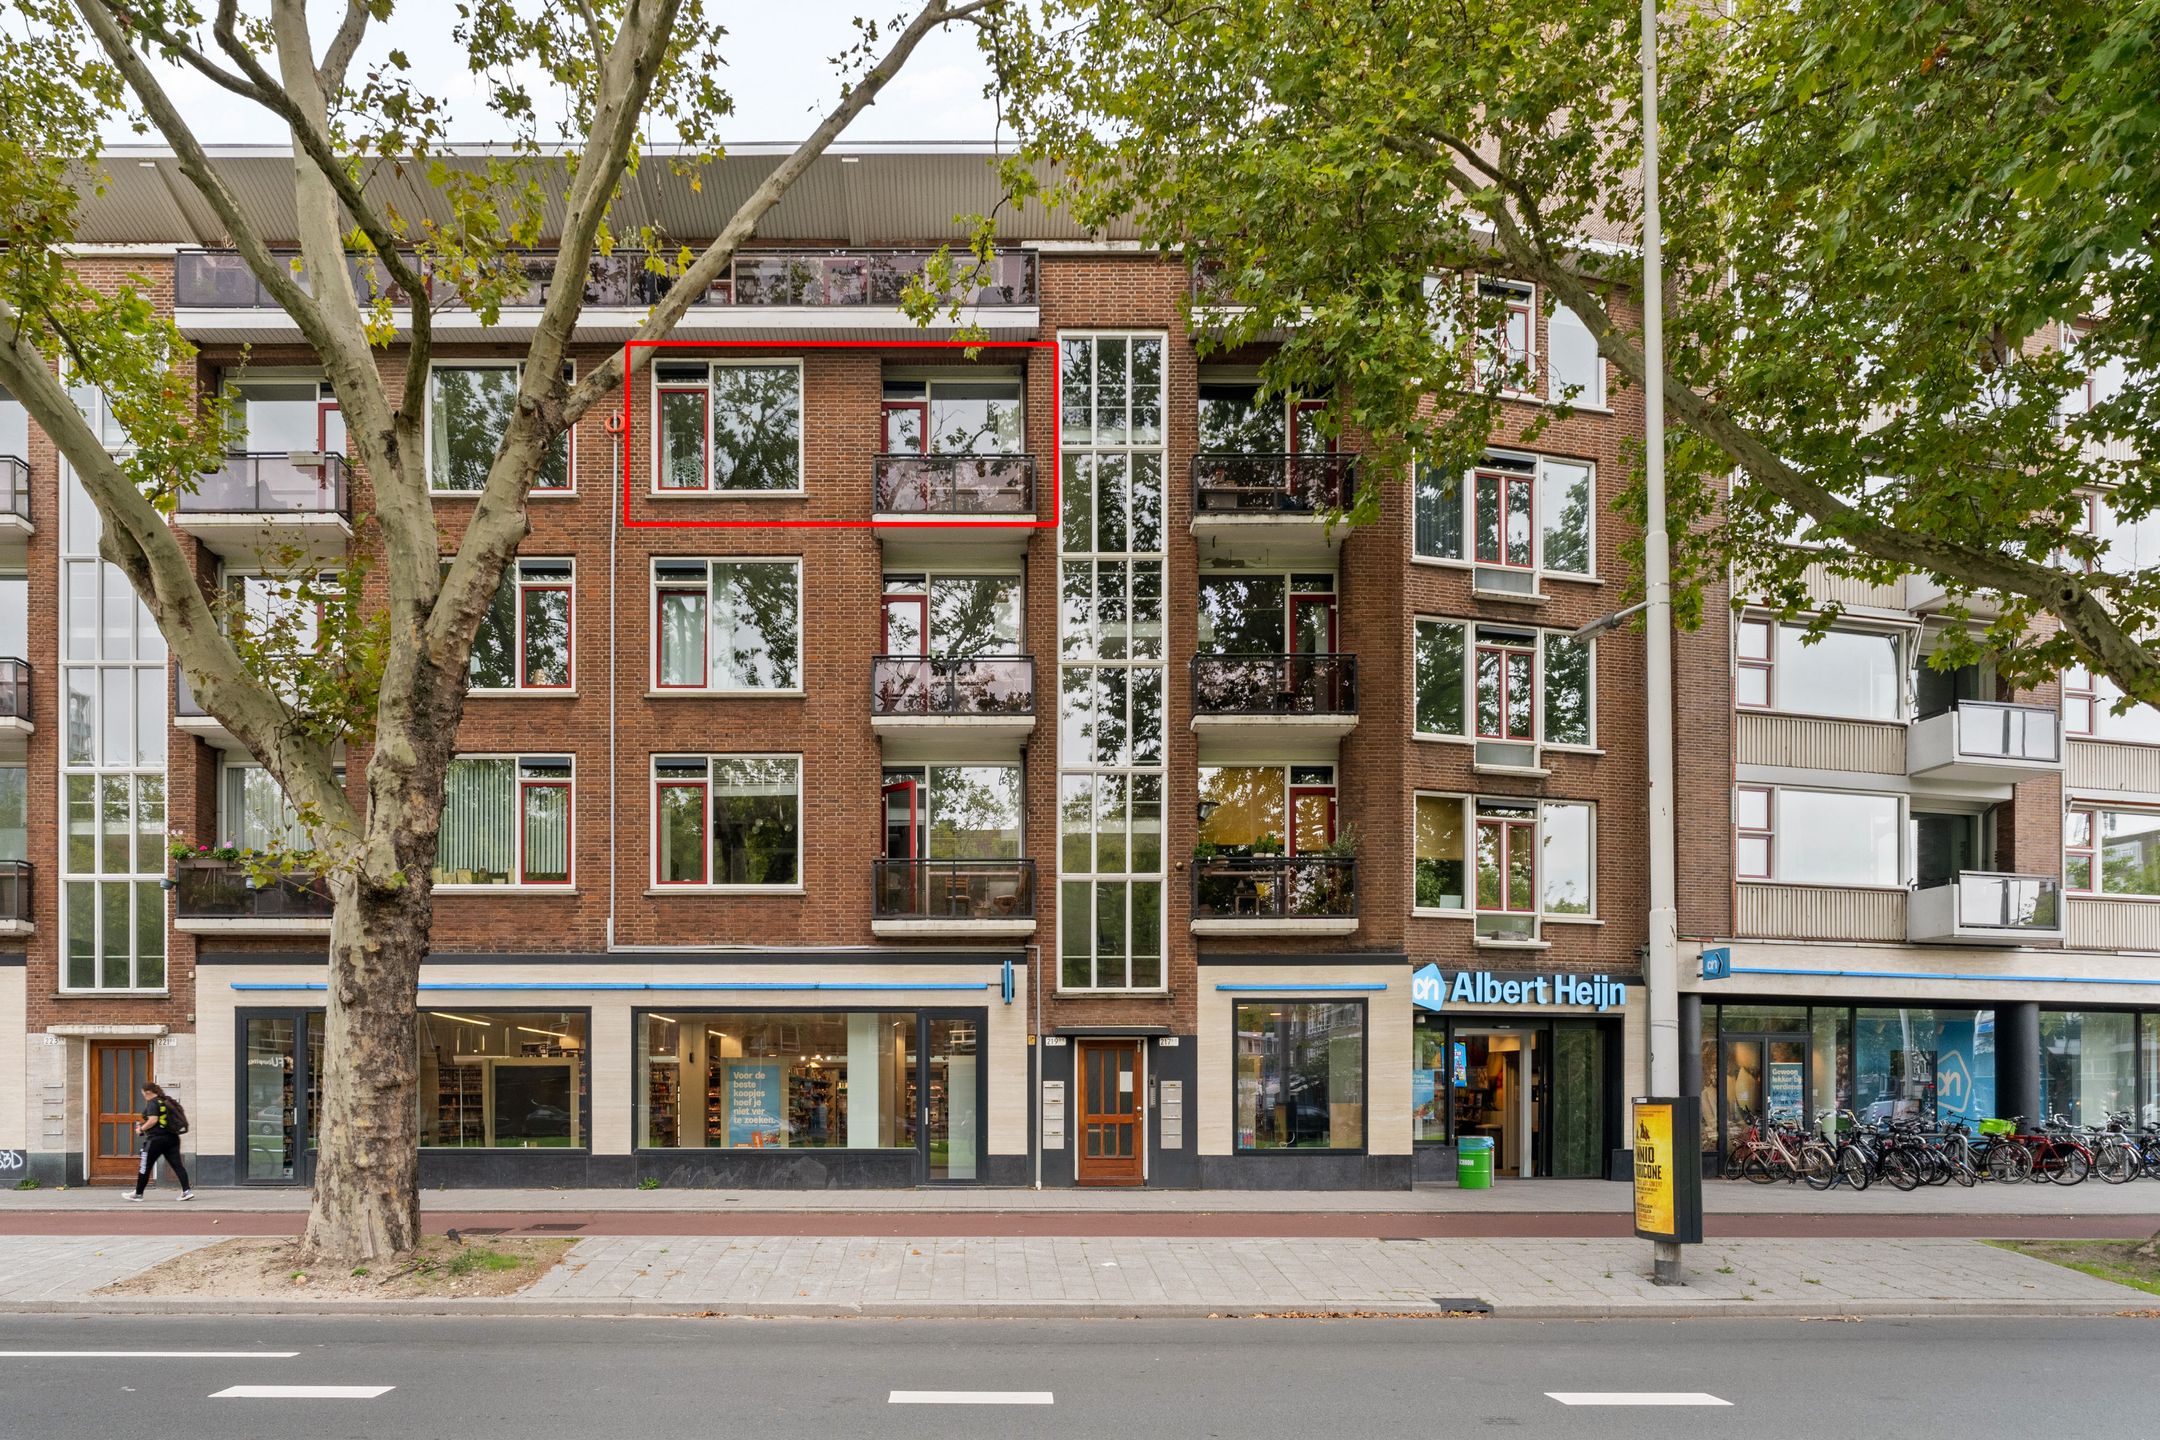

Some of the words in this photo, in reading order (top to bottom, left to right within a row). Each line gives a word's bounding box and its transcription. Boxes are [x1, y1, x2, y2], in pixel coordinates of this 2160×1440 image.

[1450, 971, 1548, 1005] Albert
[1553, 973, 1626, 1012] Heijn
[733, 1089, 765, 1098] koopjes
[733, 1098, 752, 1106] hoef
[753, 1098, 761, 1107] je
[733, 1107, 749, 1115] niet
[733, 1116, 742, 1124] te
